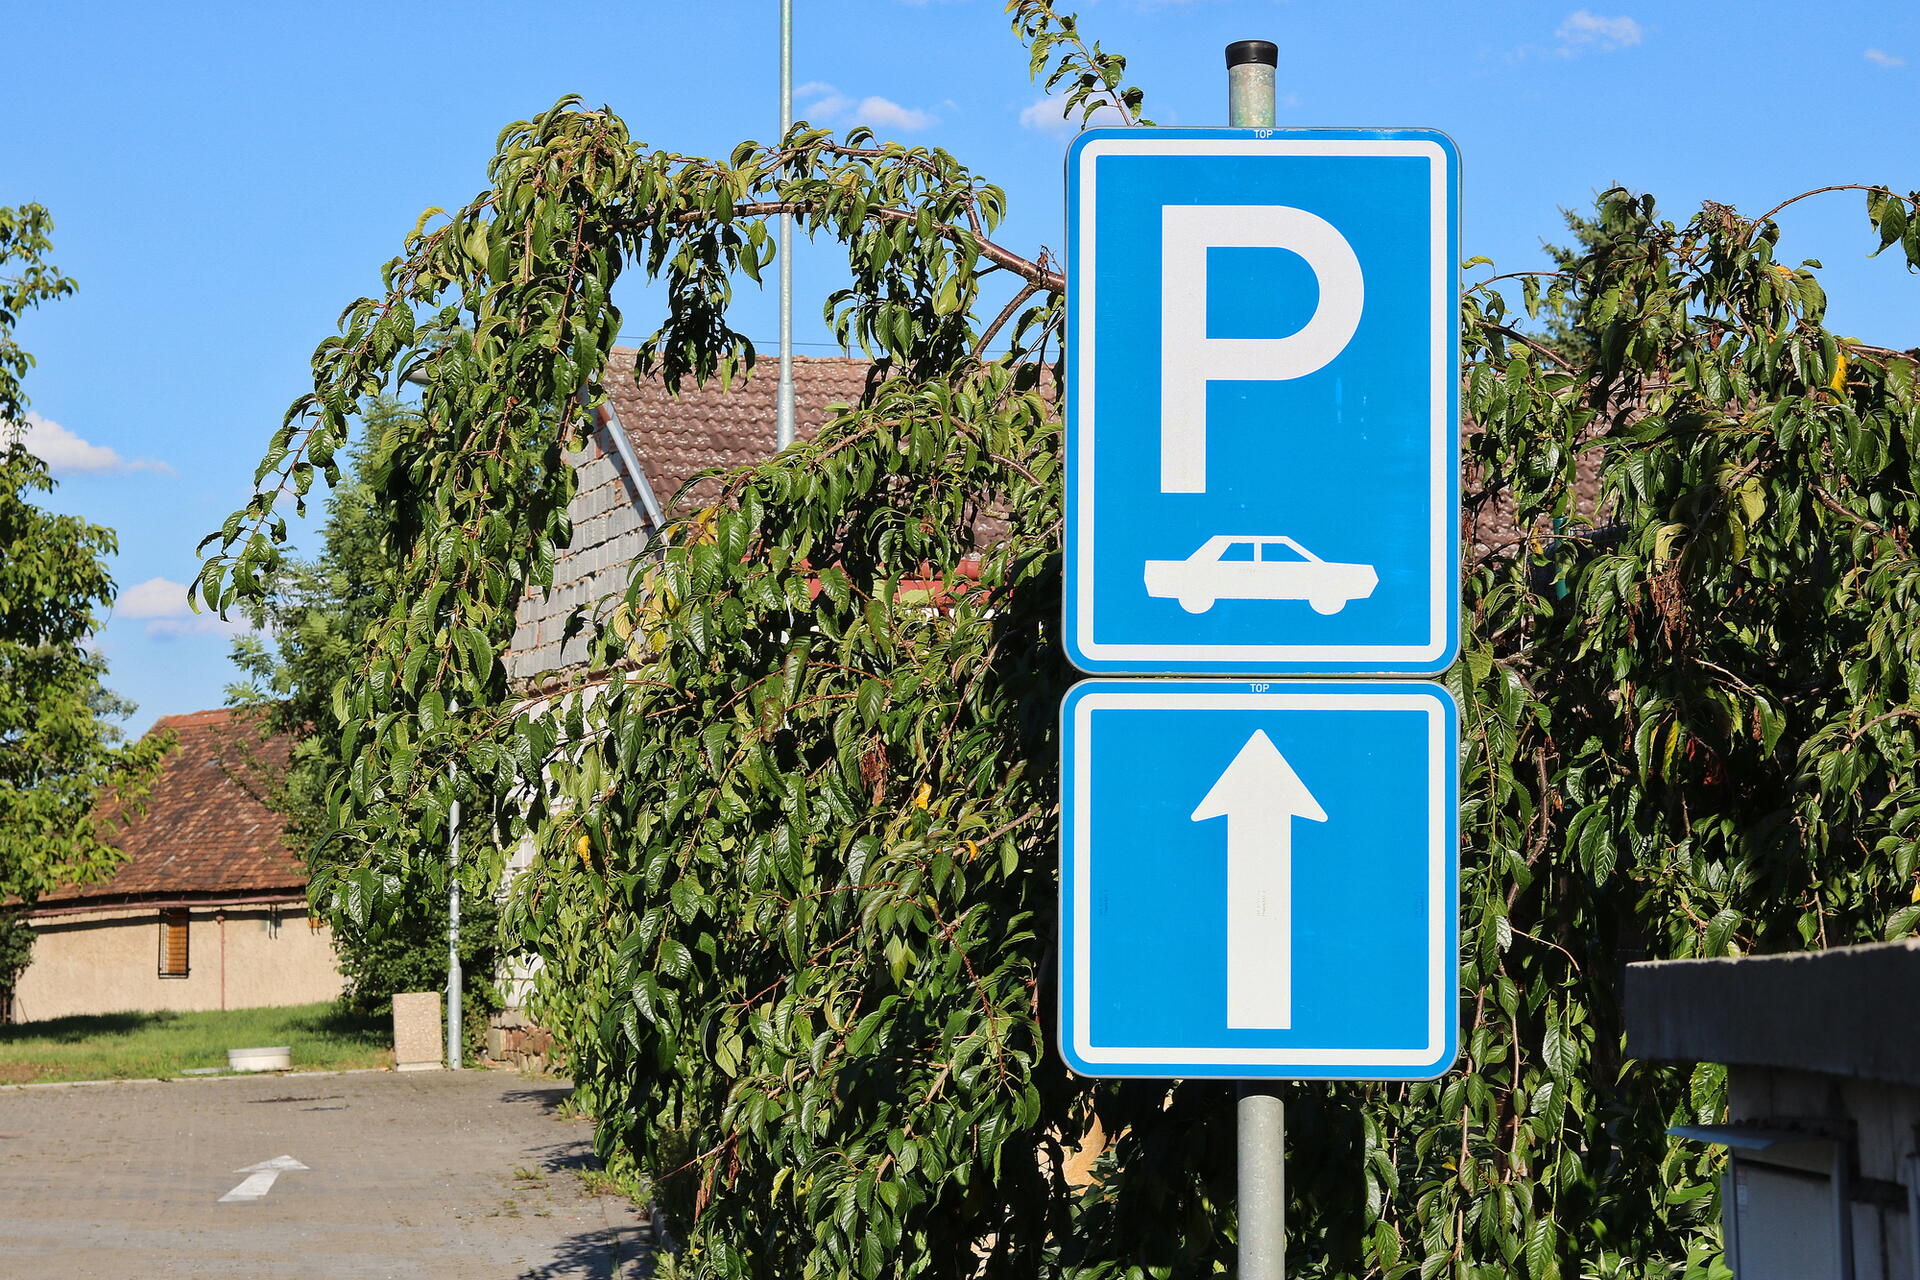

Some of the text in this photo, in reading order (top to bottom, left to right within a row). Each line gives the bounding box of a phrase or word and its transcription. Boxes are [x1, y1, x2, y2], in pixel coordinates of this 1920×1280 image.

[1253, 129, 1273, 139] TOP
[1161, 205, 1365, 493] P
[1249, 683, 1270, 693] TOP
